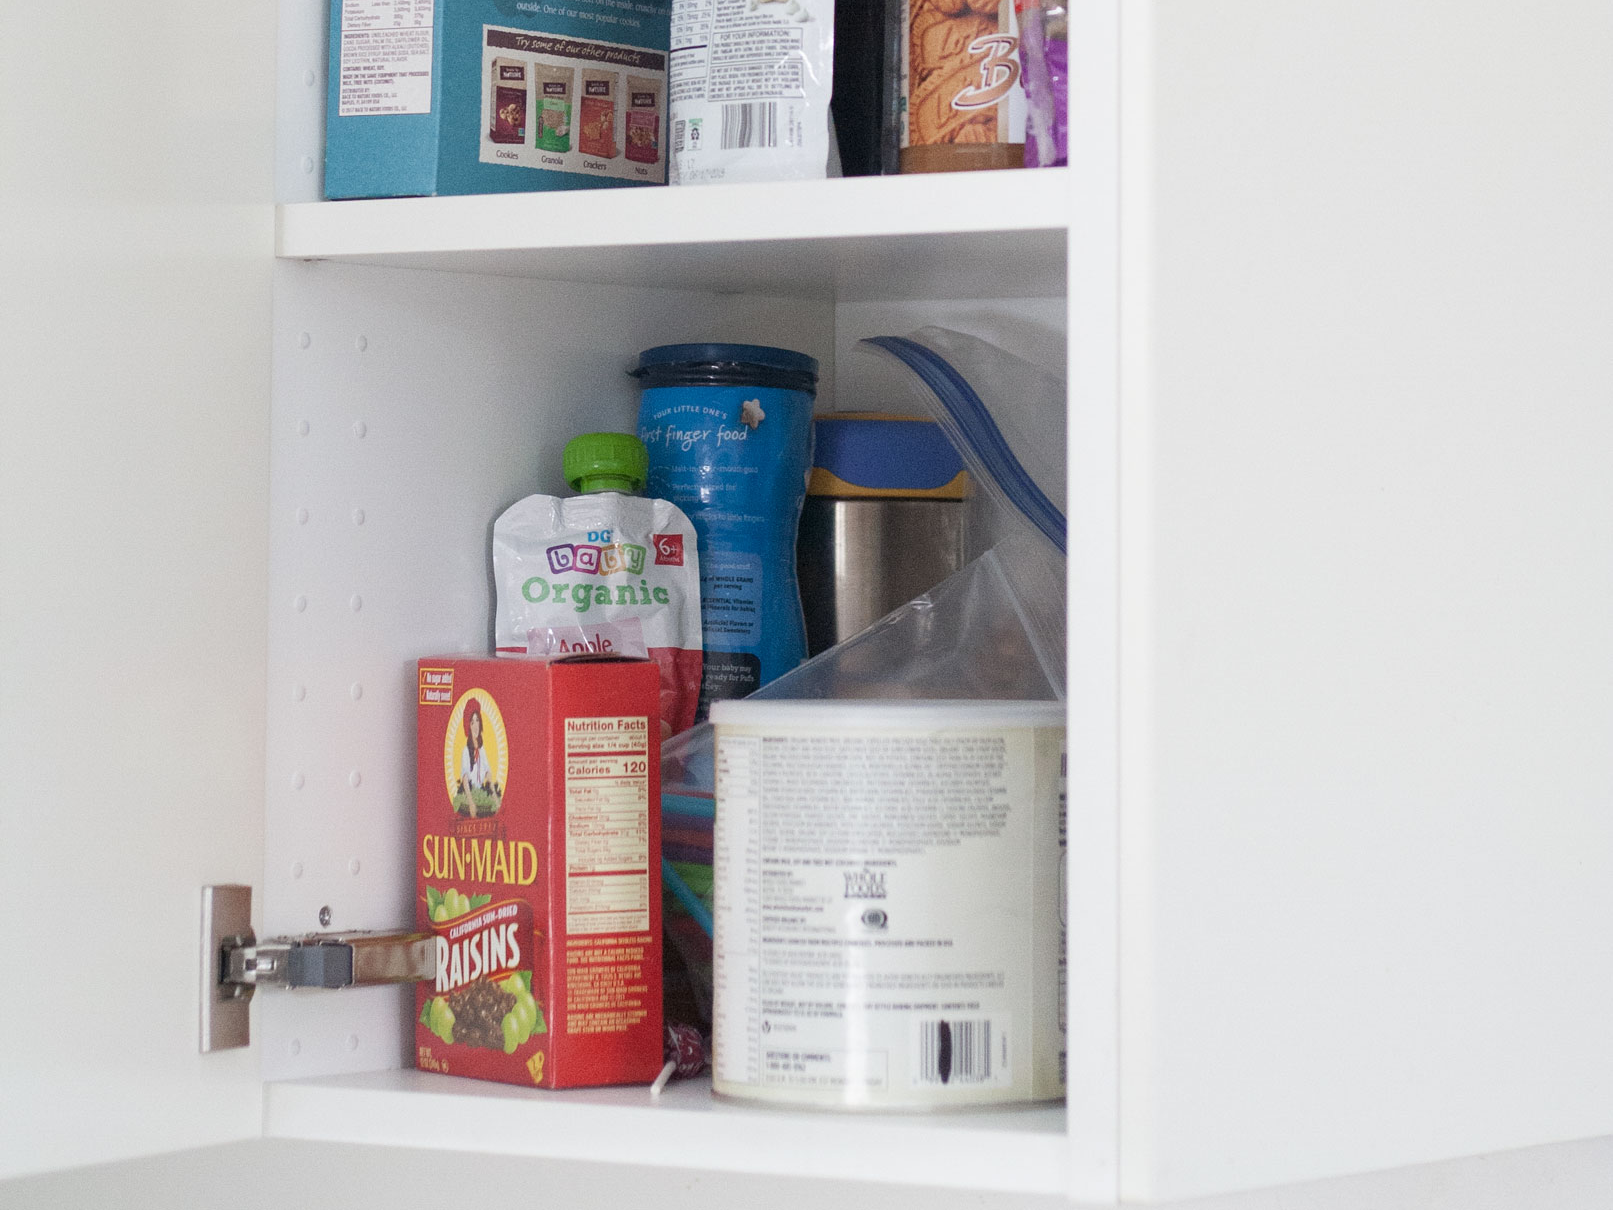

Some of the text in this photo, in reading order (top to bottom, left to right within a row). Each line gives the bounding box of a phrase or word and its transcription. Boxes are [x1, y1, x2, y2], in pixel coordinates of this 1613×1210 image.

[542, 4, 557, 14] One
[515, 36, 642, 69] Try some of our other products
[495, 150, 520, 164] Cookies
[541, 155, 565, 170] Granola
[583, 159, 608, 175] Crackers
[634, 166, 649, 179] Nuts
[653, 405, 729, 421] YOUR LITTLE ONE'S
[665, 424, 712, 452] finger
[715, 423, 749, 448] food
[587, 530, 612, 543] DG
[550, 546, 645, 573] baby
[521, 576, 671, 614] Organic
[721, 664, 738, 674] baby
[567, 718, 646, 732] Nutrition Facts
[567, 761, 647, 776] Calories 120
[450, 916, 483, 940] CALIFORNIA
[435, 922, 520, 993] RAISINS
